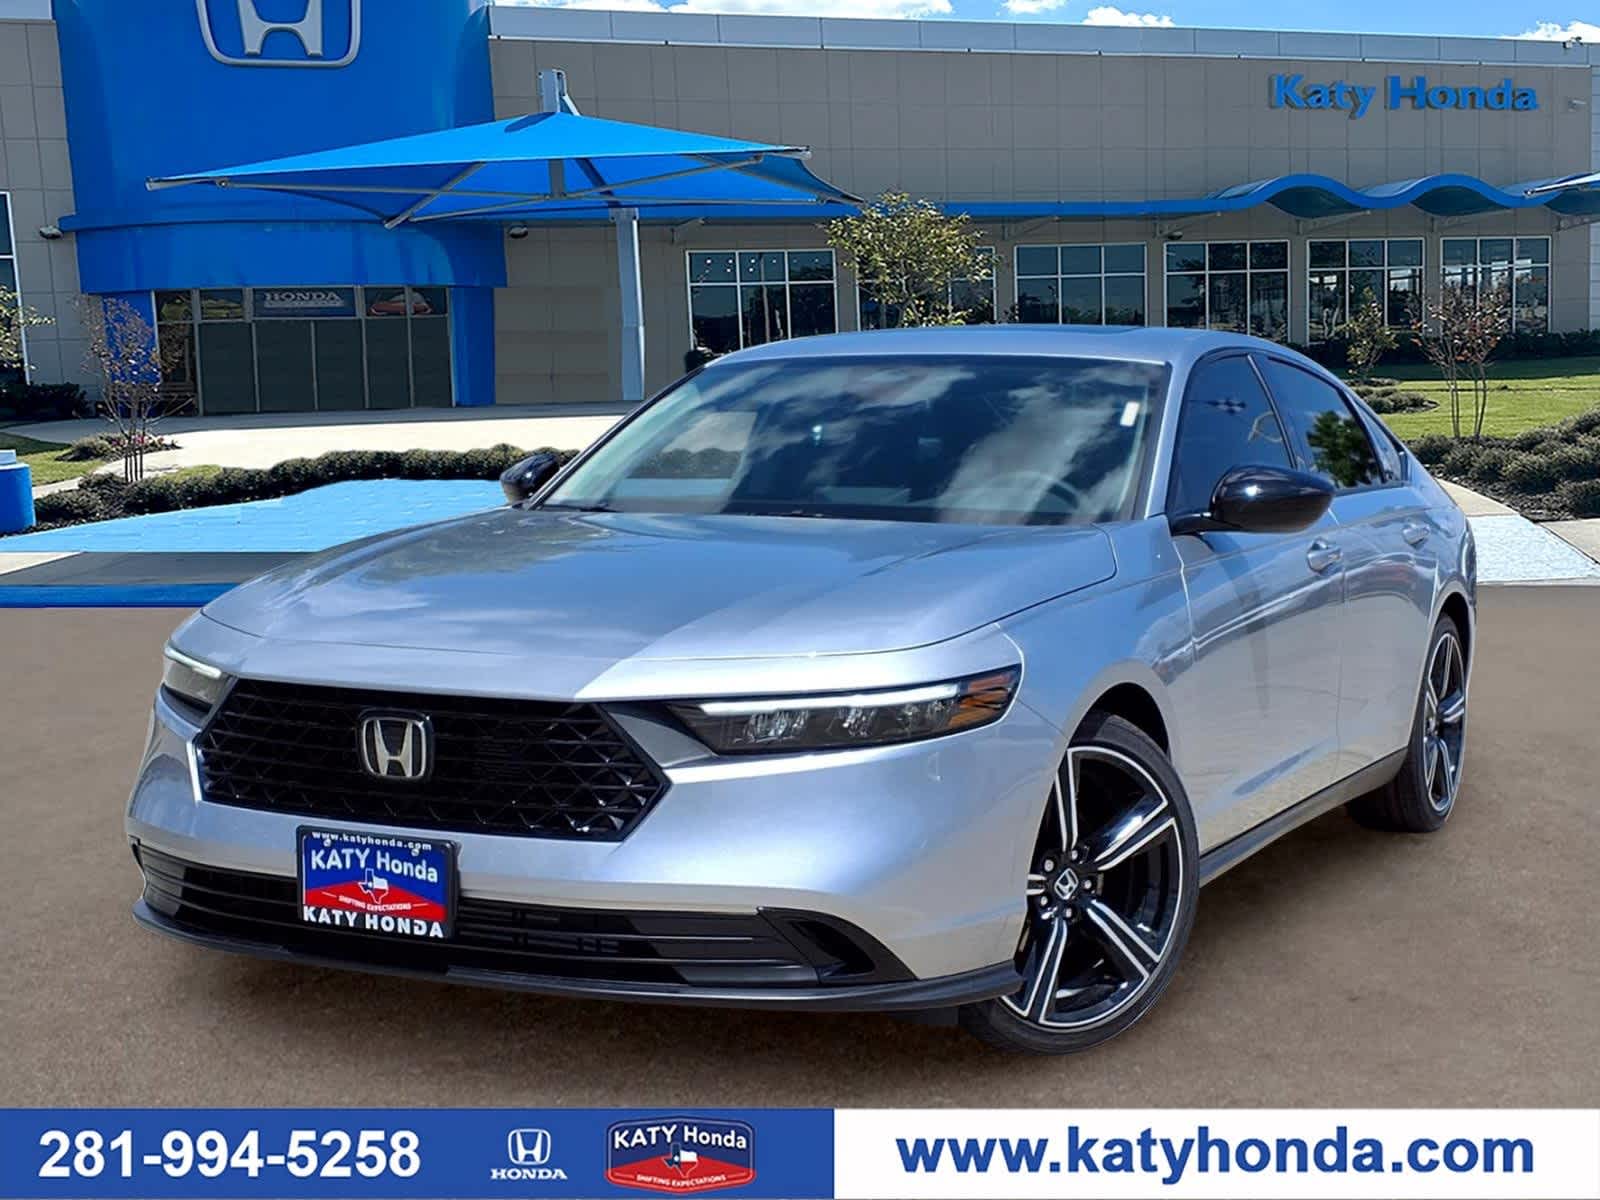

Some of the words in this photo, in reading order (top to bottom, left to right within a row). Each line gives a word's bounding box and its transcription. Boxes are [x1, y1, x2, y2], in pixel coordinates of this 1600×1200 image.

[1271, 74, 1376, 119] Katy
[1385, 75, 1539, 111] Honda
[263, 292, 342, 301] HONDA
[311, 831, 432, 851] www.katyhonda.com
[311, 848, 370, 870] KATY
[376, 851, 438, 883] Honda
[303, 906, 358, 928] KATY
[365, 914, 444, 938] HONDA
